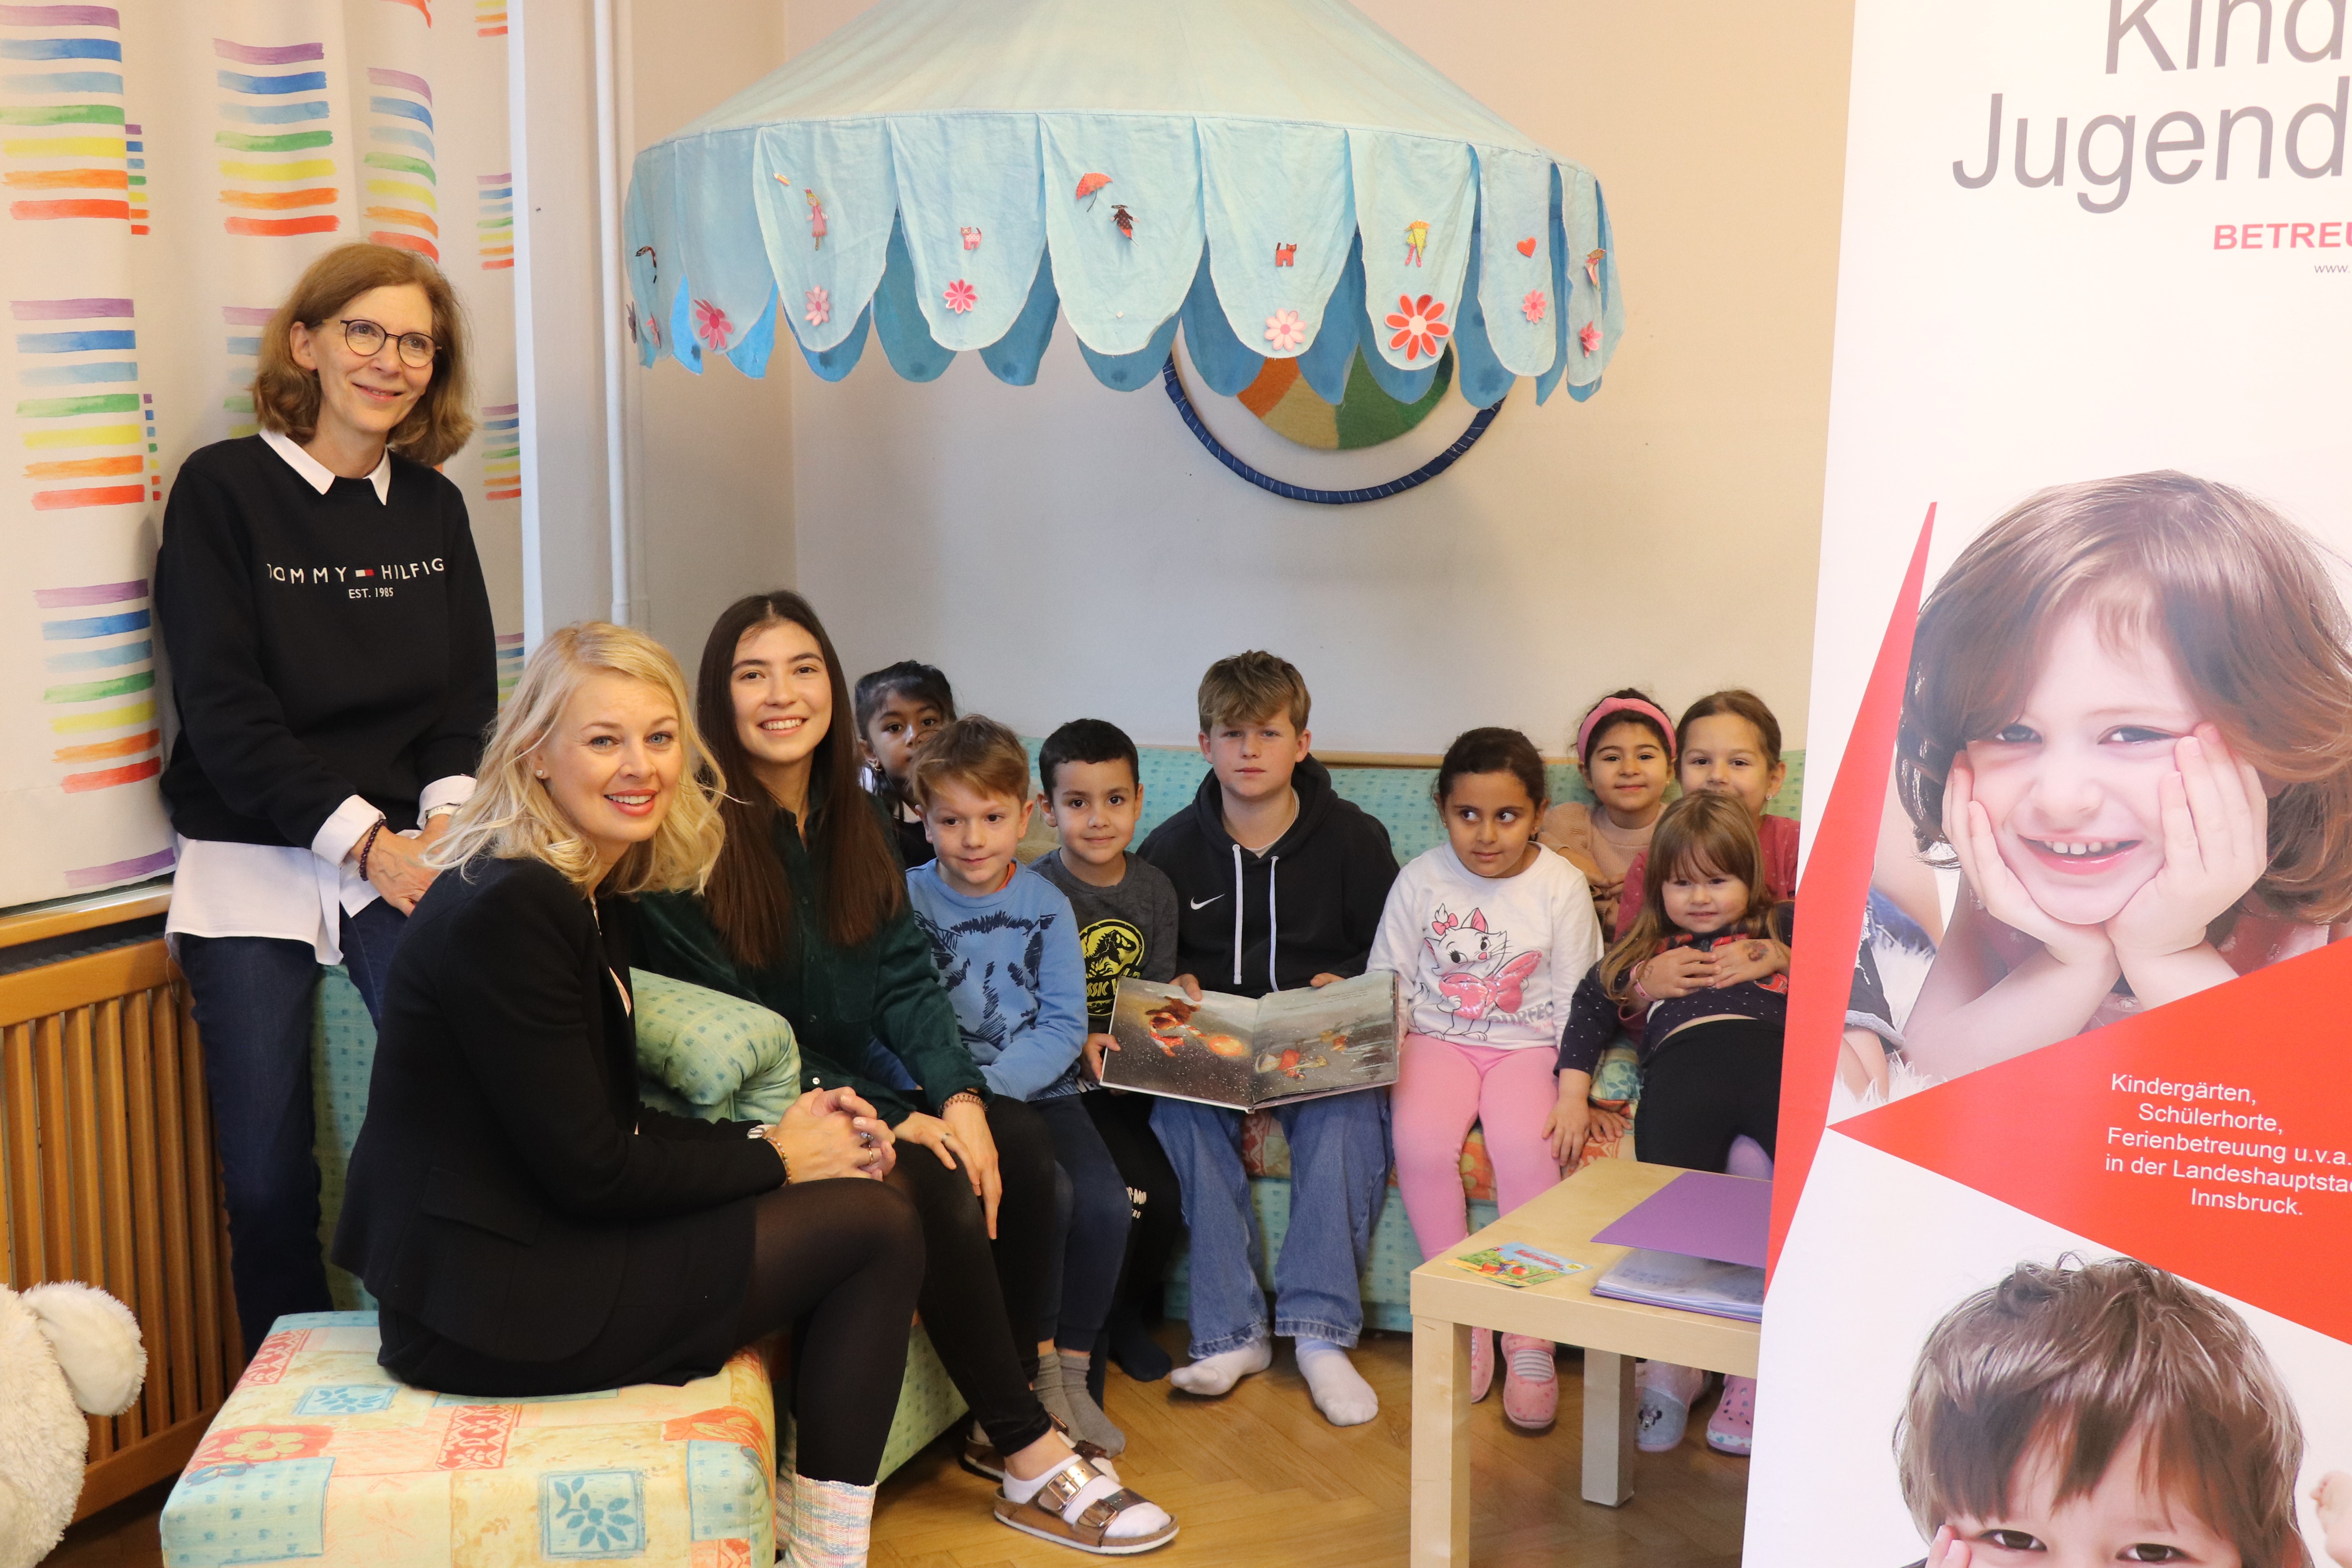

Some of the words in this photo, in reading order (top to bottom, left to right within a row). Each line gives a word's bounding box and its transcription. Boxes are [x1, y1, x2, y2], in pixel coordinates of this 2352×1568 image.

[1952, 76, 2350, 214] Jugend
[2213, 222, 2352, 250] BETRE
[348, 588, 371, 599] EST.
[375, 587, 394, 598] 1985
[2111, 1073, 2256, 1106] Kindergärten,
[2138, 1103, 2282, 1135] Schülerhorte,
[2108, 1127, 2286, 1164] Ferienbetreuung
[2294, 1148, 2352, 1166] u.v.a.
[2106, 1153, 2123, 1172] in
[2131, 1156, 2167, 1175] der
[2173, 1160, 2352, 1193] Landeshauptsta
[2192, 1188, 2303, 1215] Innsbruck.
